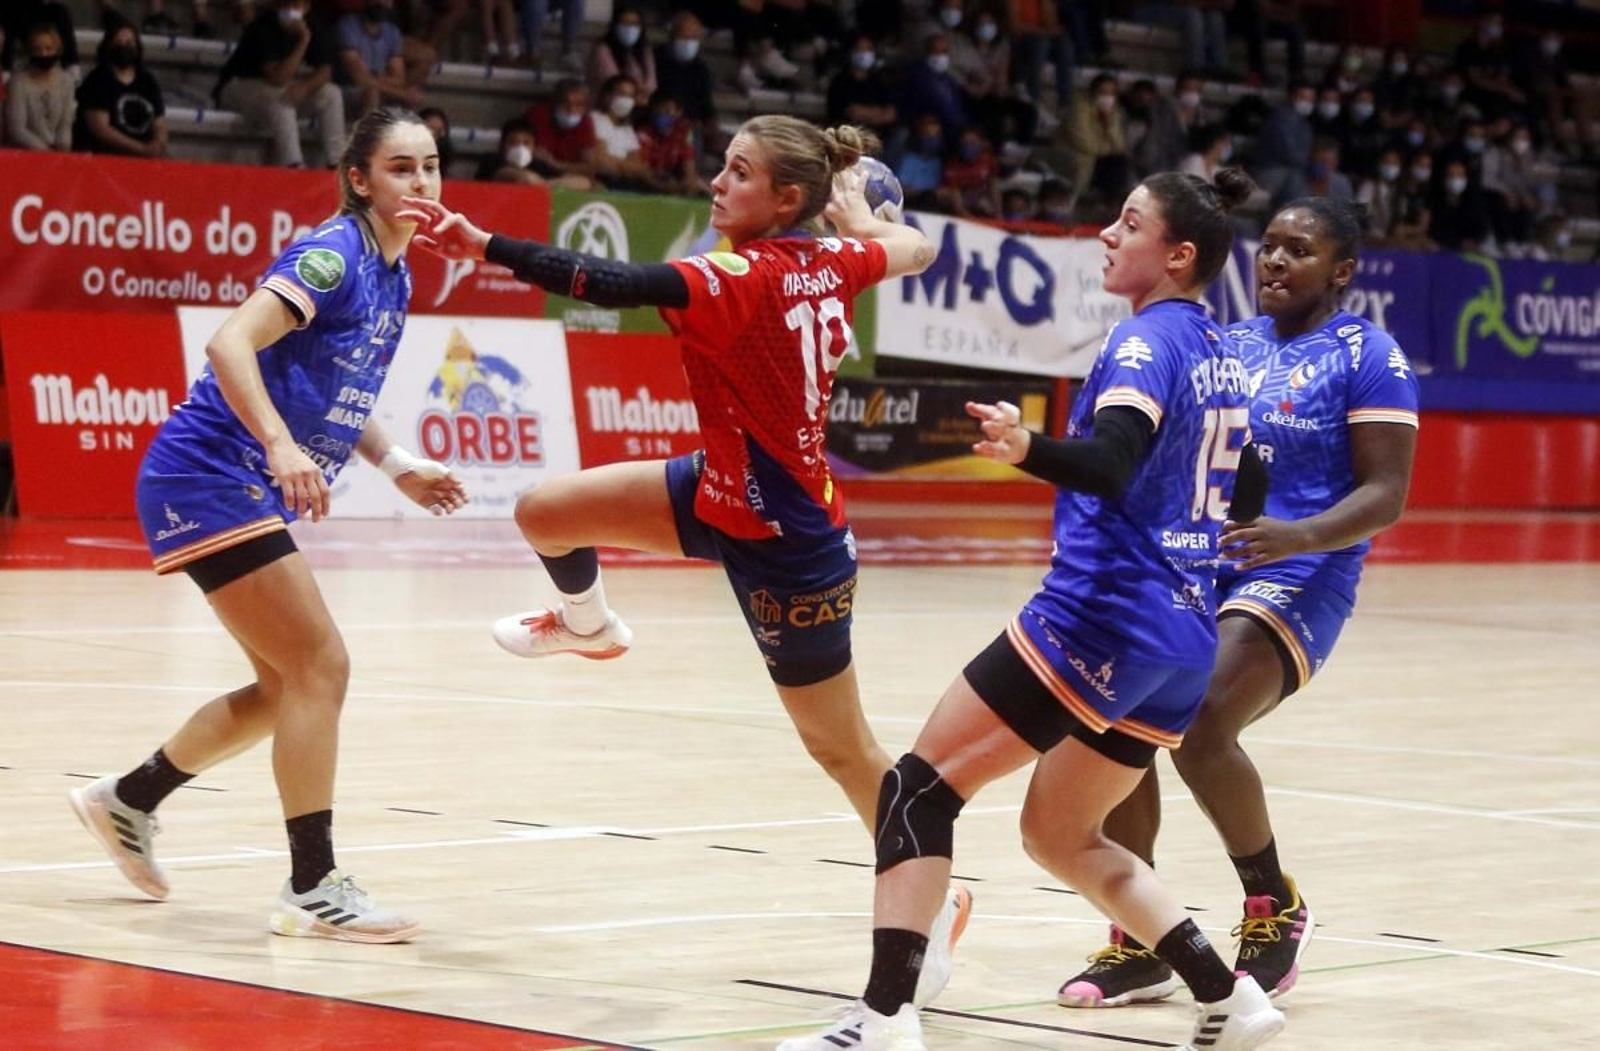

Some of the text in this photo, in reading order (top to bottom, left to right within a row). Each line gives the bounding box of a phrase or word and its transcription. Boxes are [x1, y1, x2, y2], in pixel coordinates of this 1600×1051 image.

[12, 194, 192, 252] Concello
[206, 205, 256, 255] do
[83, 266, 248, 301] O Concello do
[31, 373, 169, 426] Mahou
[586, 386, 701, 433] Mahou
[80, 430, 135, 451] SIN
[419, 413, 544, 464] ORBE
[624, 437, 673, 456] SIN
[1191, 407, 1253, 522] 15
[1161, 530, 1210, 549] SUPER
